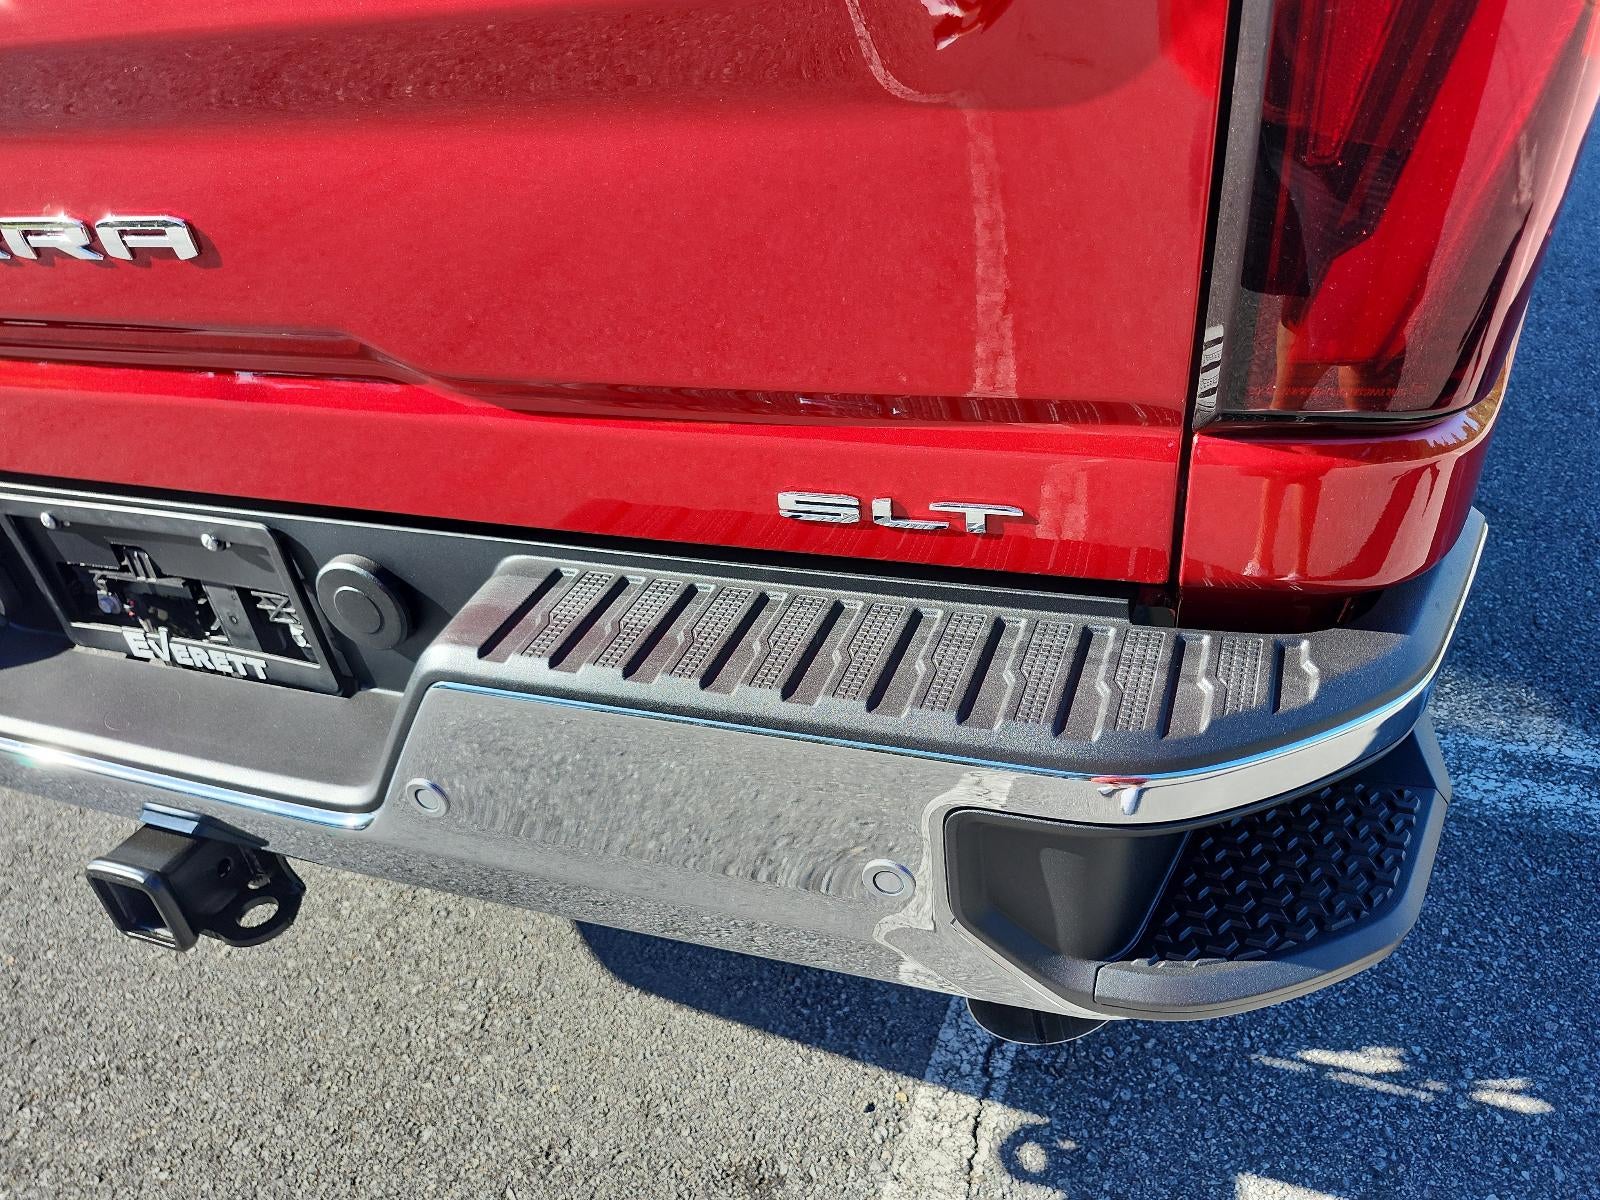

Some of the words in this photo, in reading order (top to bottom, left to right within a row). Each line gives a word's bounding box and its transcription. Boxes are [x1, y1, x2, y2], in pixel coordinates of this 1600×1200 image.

[0, 215, 199, 260] RA
[778, 491, 1024, 534] SLT
[122, 626, 267, 680] EVERETT
